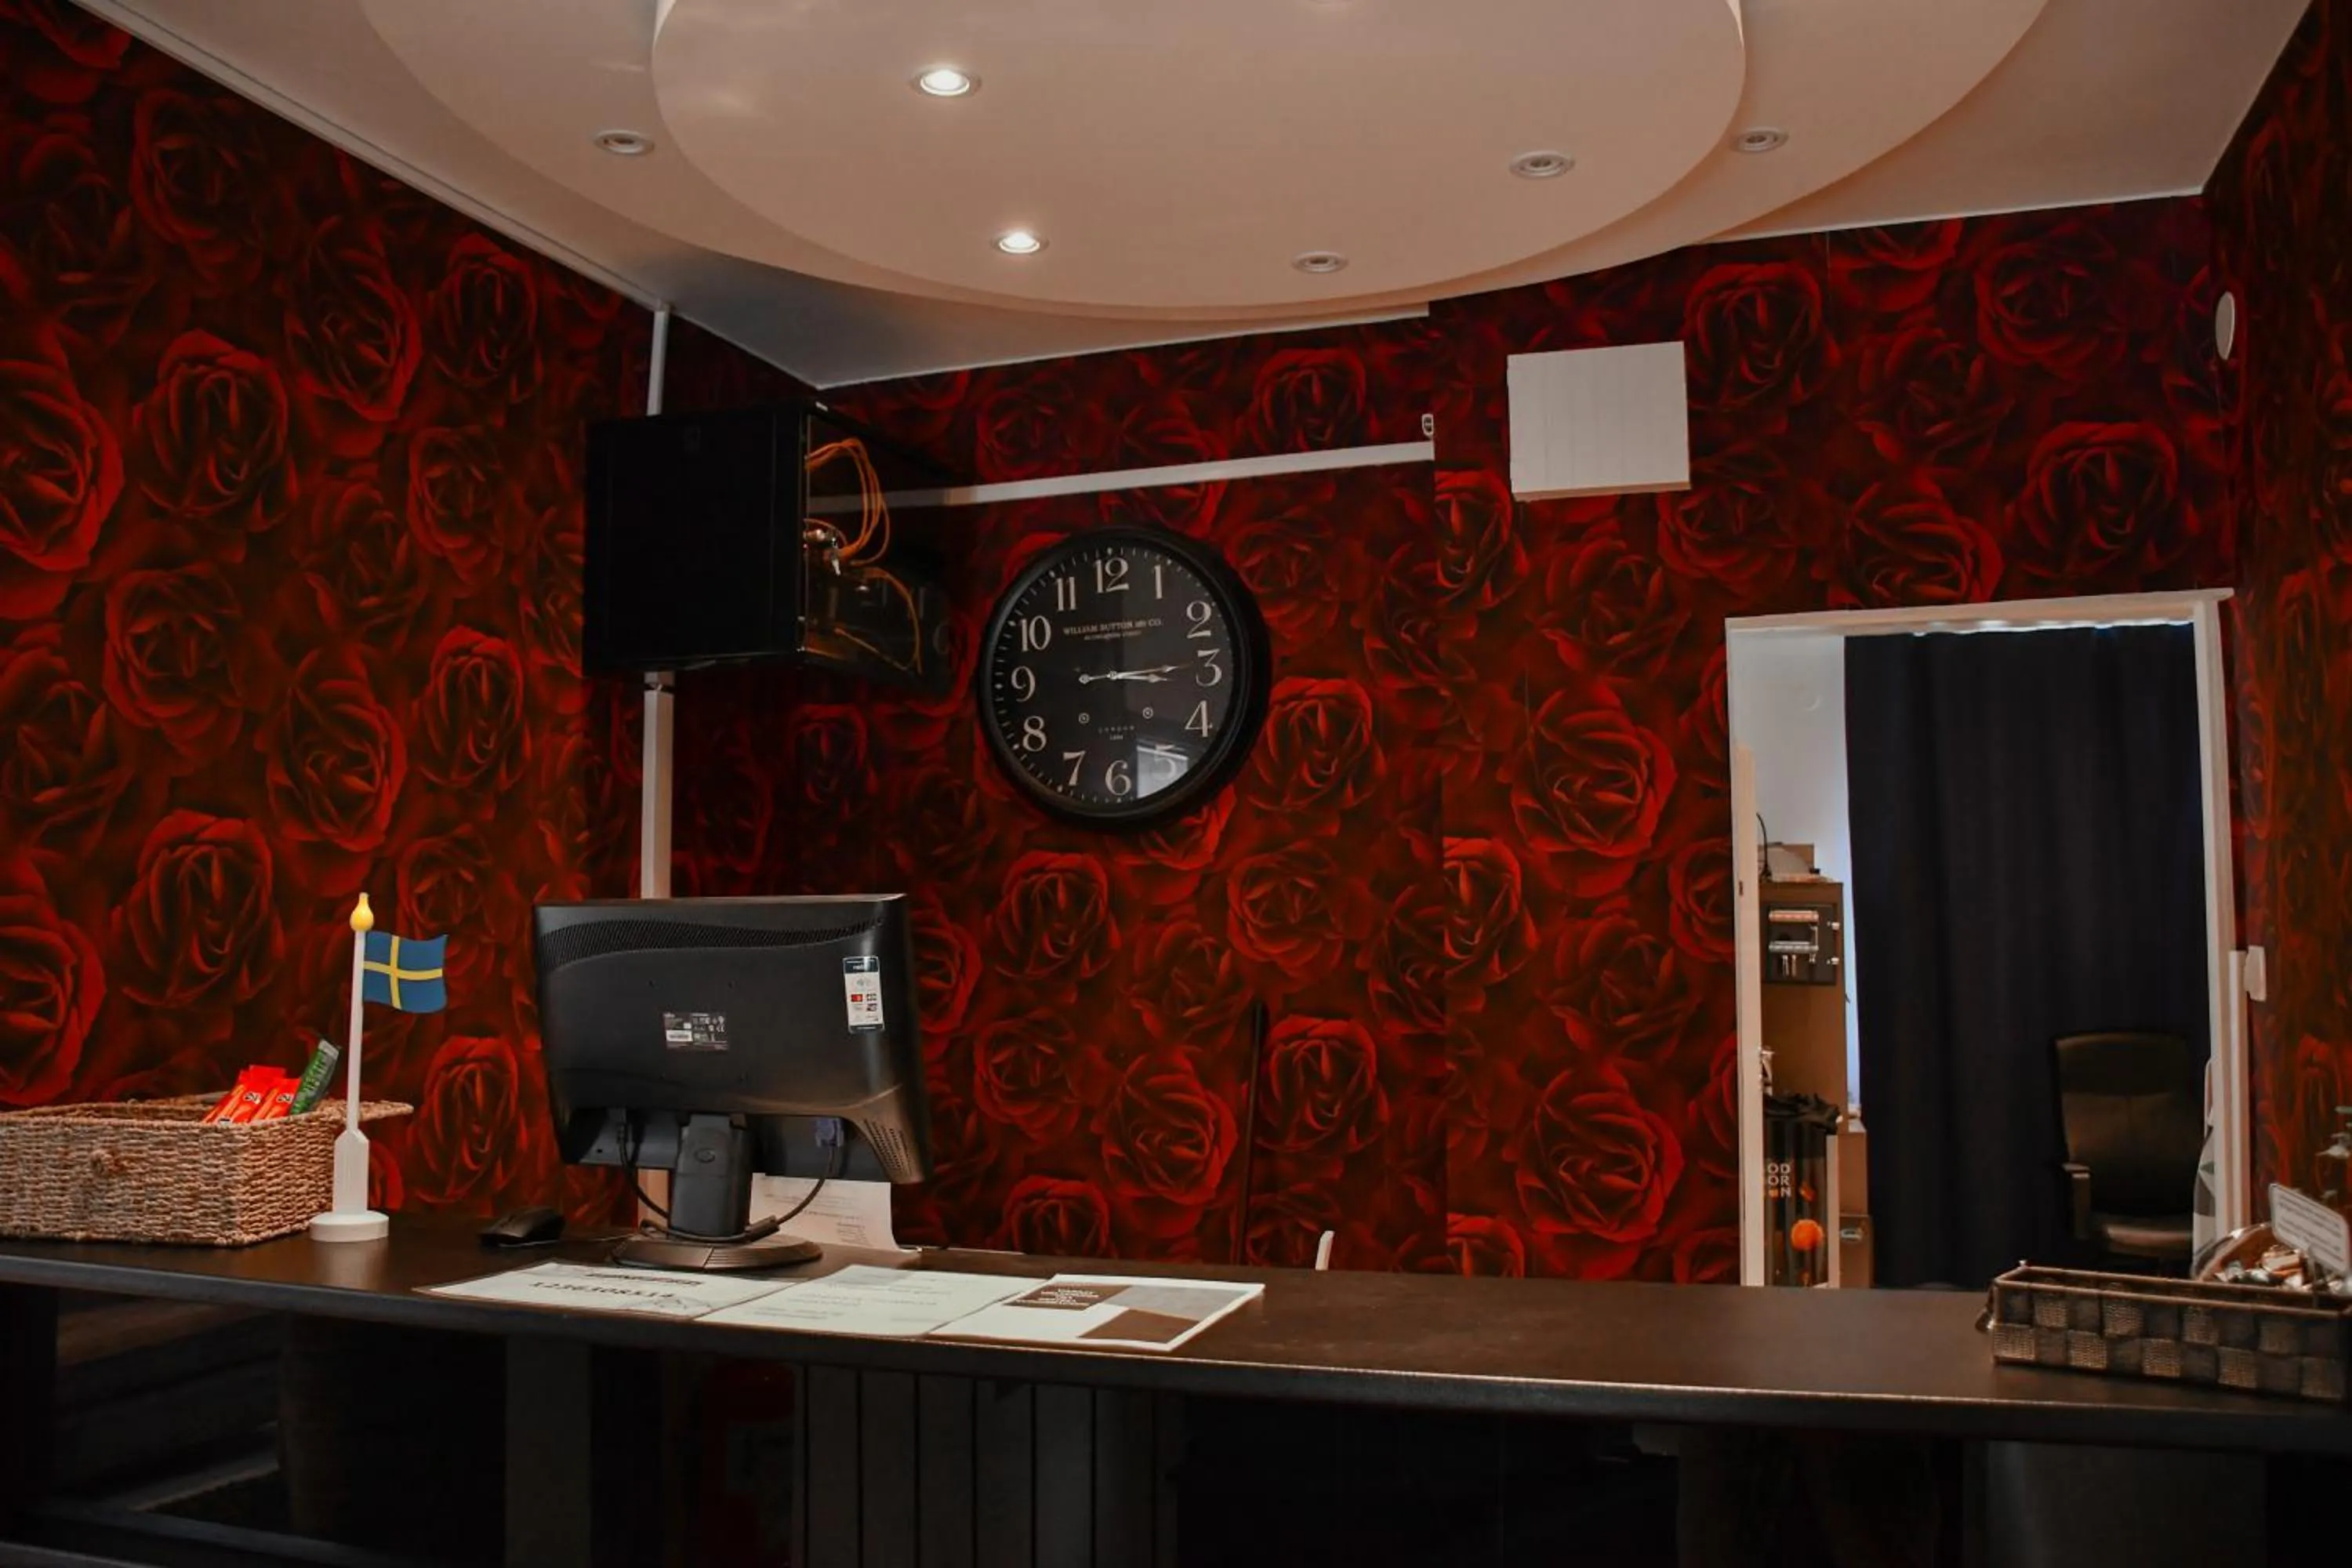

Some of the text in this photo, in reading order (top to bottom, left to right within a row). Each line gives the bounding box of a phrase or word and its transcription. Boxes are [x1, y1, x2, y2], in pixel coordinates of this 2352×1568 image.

[1056, 575, 1077, 612] 11
[1094, 557, 1130, 593] 12
[1152, 564, 1163, 599] 1
[1020, 615, 1052, 652] 10
[1062, 624, 1098, 636] WILLIAM
[1185, 601, 1212, 639] 2
[1011, 666, 1036, 702] 9
[1196, 648, 1222, 688] 3
[1022, 715, 1047, 753] 8
[1185, 700, 1213, 738] 4
[1062, 750, 1087, 787] 7
[1105, 760, 1132, 796] 6
[1152, 744, 1176, 780] 5
